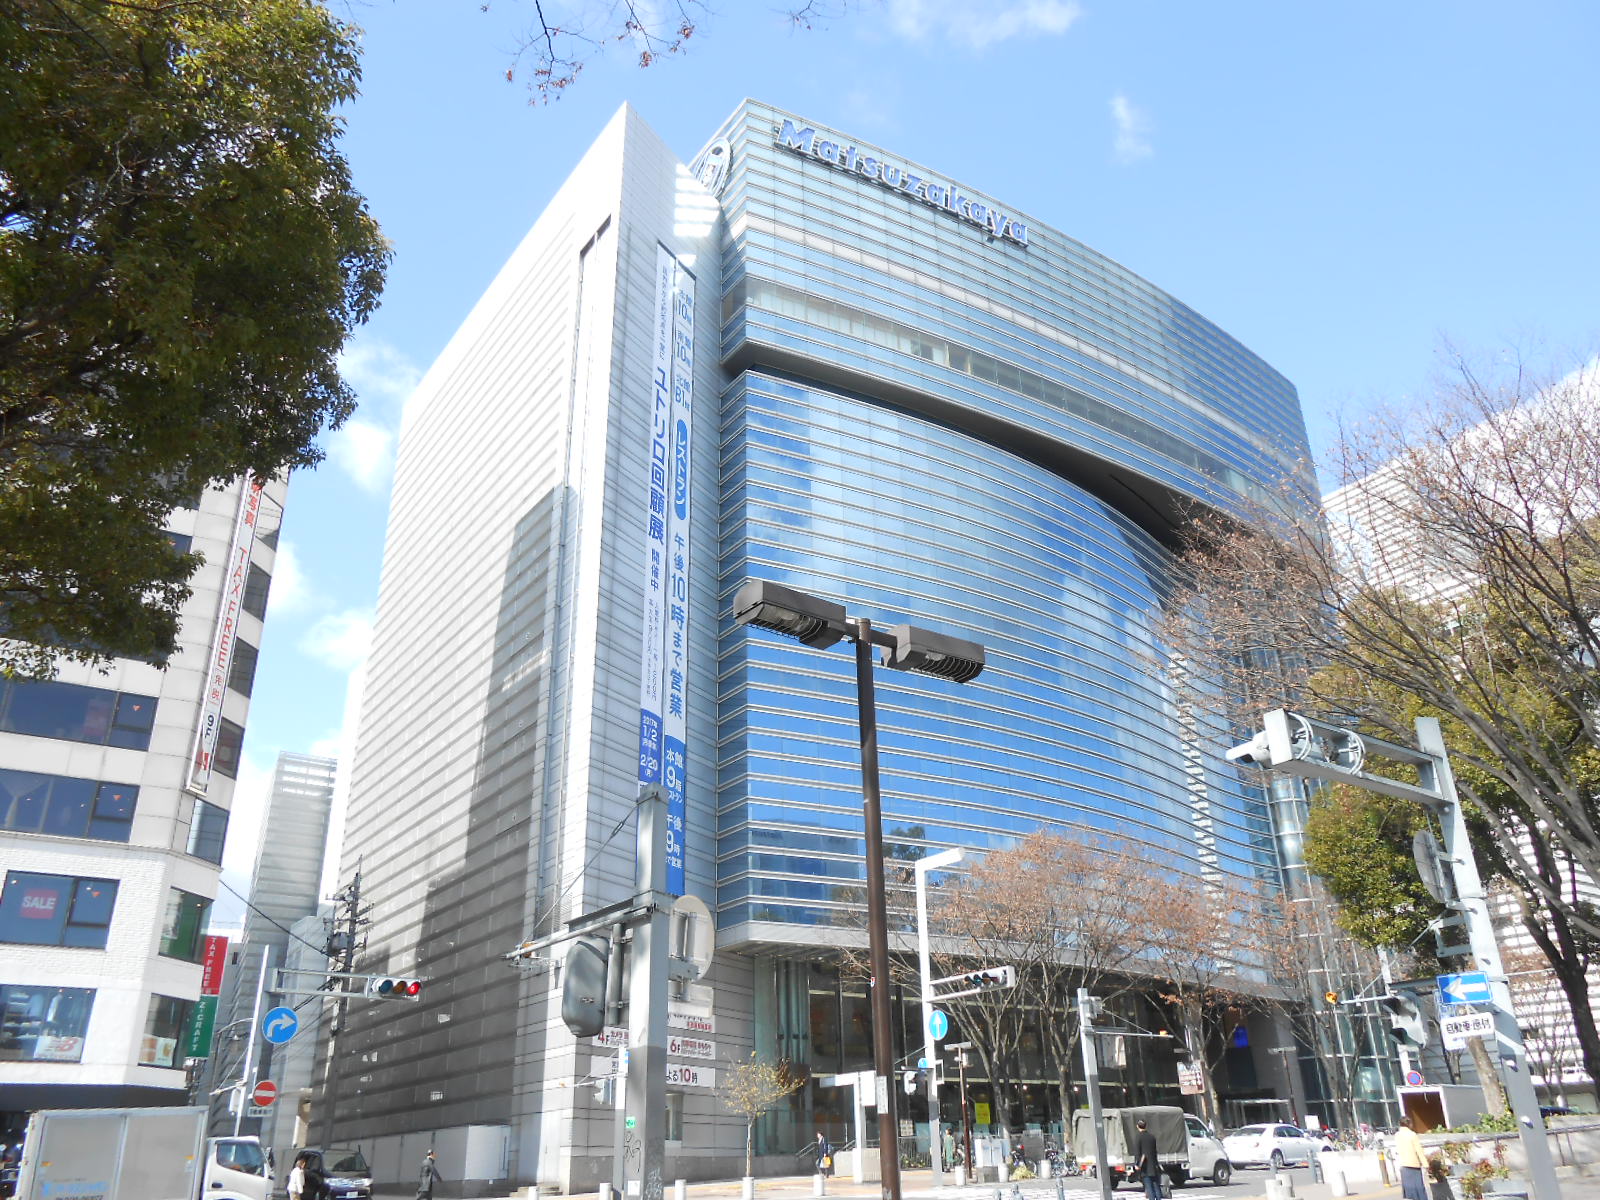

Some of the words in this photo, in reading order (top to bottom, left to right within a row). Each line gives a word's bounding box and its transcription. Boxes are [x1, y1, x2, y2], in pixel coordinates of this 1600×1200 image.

[777, 119, 1028, 244] Matsuzakaya
[649, 366, 668, 545] ユトリロ回顧展
[676, 431, 686, 505] レストラン
[232, 546, 248, 599] TAX
[650, 548, 660, 591] 開催中
[217, 599, 237, 669] FREE
[211, 675, 223, 700] 免税
[205, 714, 215, 739] 9F
[643, 725, 658, 741] 1/2
[668, 790, 683, 804] ストラン
[23, 896, 56, 909] SALE
[209, 937, 217, 957] TAX
[670, 1039, 680, 1053] 6F
